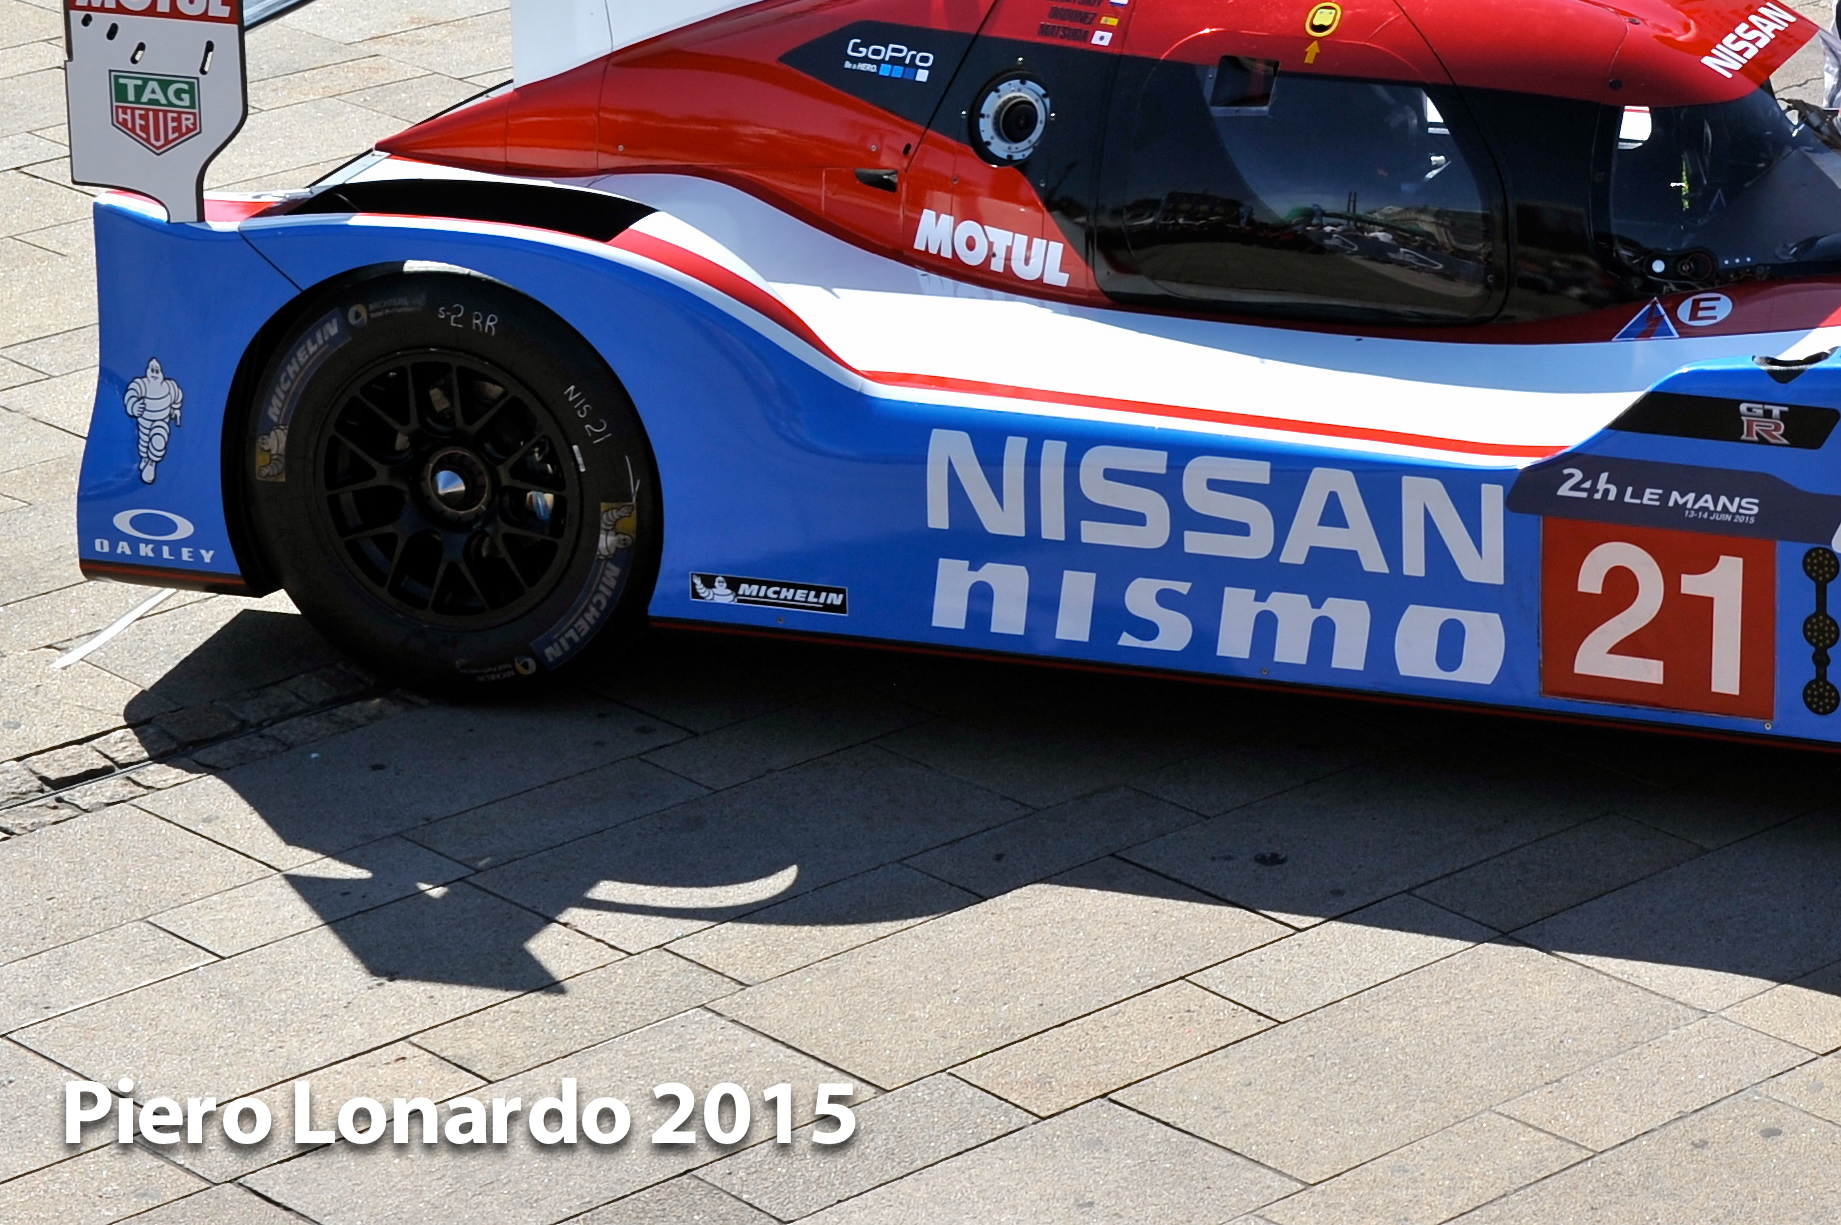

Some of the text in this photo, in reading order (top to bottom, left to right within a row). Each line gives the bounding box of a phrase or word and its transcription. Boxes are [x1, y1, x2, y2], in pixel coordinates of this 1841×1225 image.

[846, 38, 935, 68] GoPro
[1700, 1, 1797, 79] NISSAN
[117, 76, 191, 107] TAG
[117, 107, 195, 147] HEUER
[914, 208, 1071, 288] MOTUL
[472, 311, 500, 336] RR
[1687, 296, 1723, 322] E
[265, 316, 339, 424] MICHELIN
[563, 384, 593, 420] NIS
[1739, 402, 1790, 419] GT
[1740, 416, 1791, 445] R
[926, 428, 1505, 586] NISSAN
[1556, 468, 1760, 516] 24h LE MANS
[1684, 508, 1756, 525] 13-14 JUIN 2015
[94, 537, 215, 564] OAKLEY
[546, 559, 619, 664] MICHELIN
[736, 582, 846, 608] MICHELIN
[930, 558, 1505, 685] nismo
[1572, 540, 1744, 696] 21
